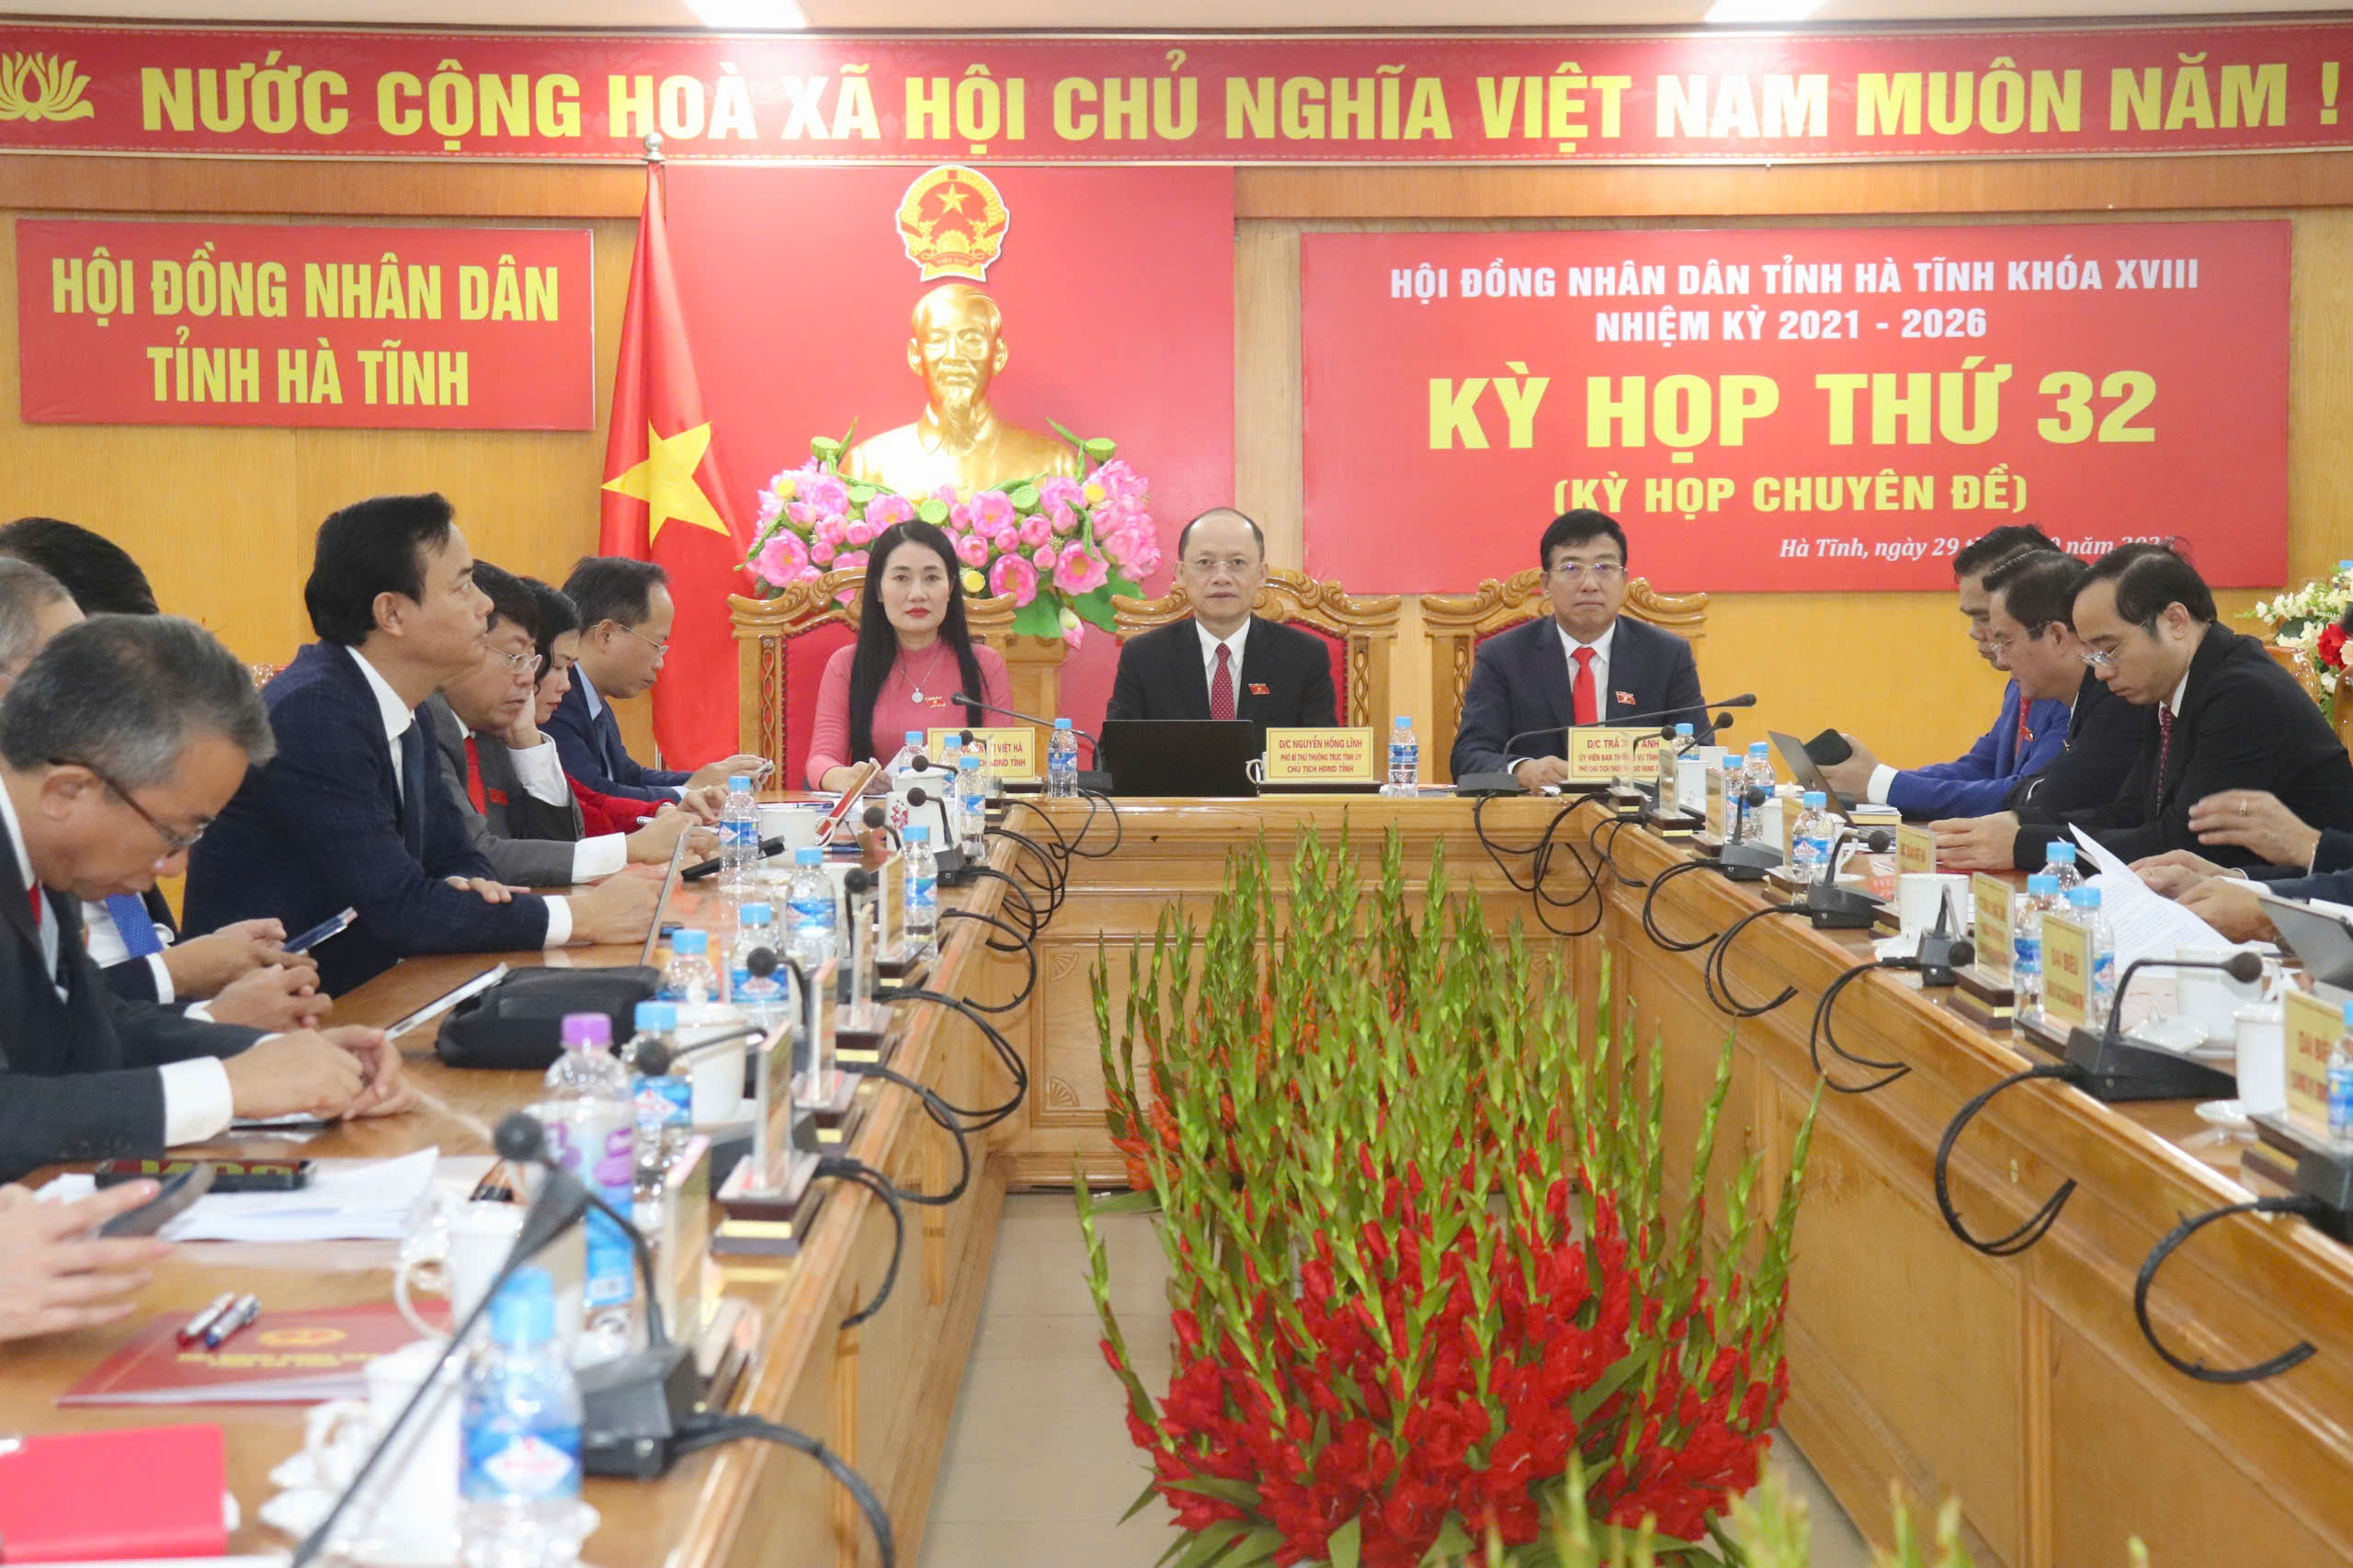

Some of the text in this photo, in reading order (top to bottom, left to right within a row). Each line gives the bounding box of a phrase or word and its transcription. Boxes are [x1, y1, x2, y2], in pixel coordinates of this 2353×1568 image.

[142, 50, 2339, 155] NƯỚC CỘNG HOÀ XÃ HỘI CHỦ NGHĨA VIỆT NAM MUÔN NĂM !
[52, 242, 560, 327] HỘI ĐỒNG NHÂN DÂN
[1391, 254, 2200, 302] HỘI ĐỒNG NHÂN DÂN TỈNH HÀ TĨNH KHÓA XVIII
[1596, 304, 1988, 347] NHIỆM KỲ 2021 - 2026
[147, 326, 471, 407] TỈNH HÀ TĨNH
[1429, 355, 2157, 465] KỲ HỌP THỨ 32
[1554, 463, 2029, 520] (KỲ HỌP CHUYÊN ĐỀ)
[1779, 539, 1811, 558] Hà
[1816, 538, 1870, 561] Tĩnh,
[1875, 538, 1928, 562] ngày
[1932, 538, 1961, 557] 29
[2066, 537, 2115, 556] năm
